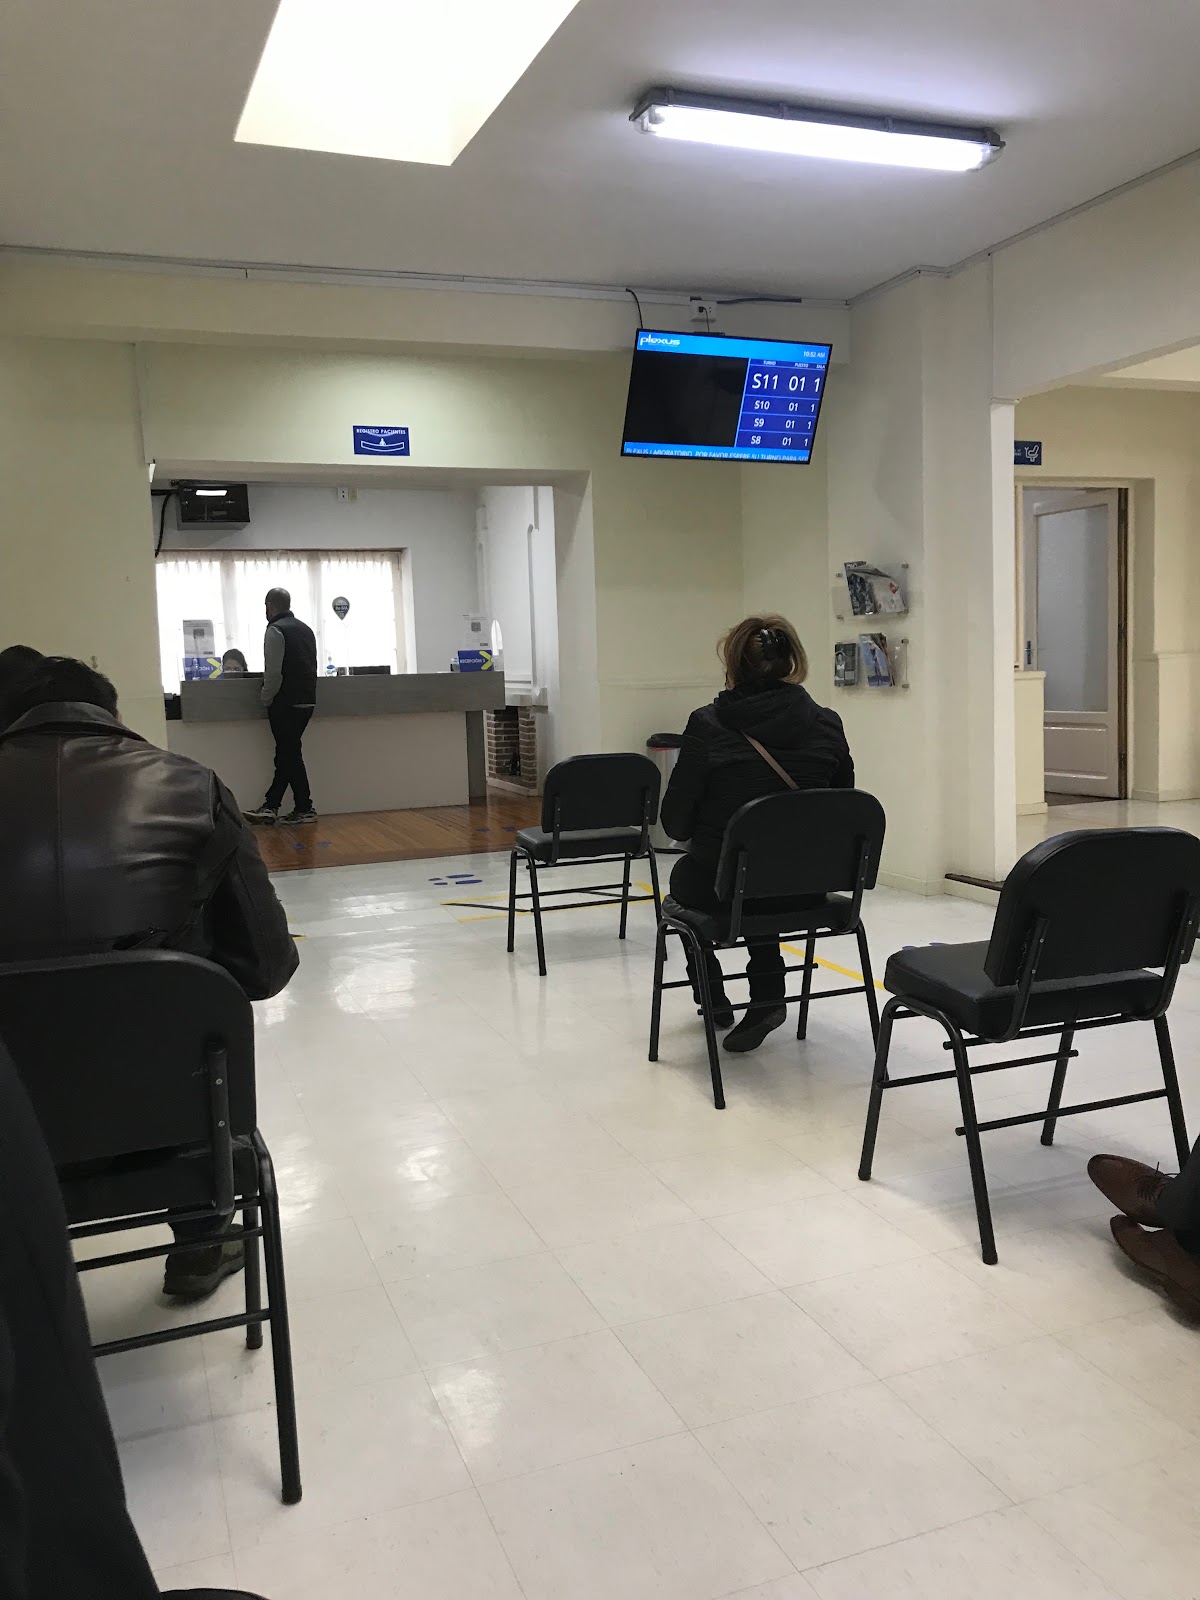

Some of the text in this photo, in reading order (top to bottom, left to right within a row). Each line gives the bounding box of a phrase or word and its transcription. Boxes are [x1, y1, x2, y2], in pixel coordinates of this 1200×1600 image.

[640, 334, 680, 346] plexus
[752, 373, 820, 393] S11 01 1
[754, 400, 815, 412] S10 01 1
[753, 418, 812, 430] S9 01 1
[751, 435, 808, 447] S8 01 1
